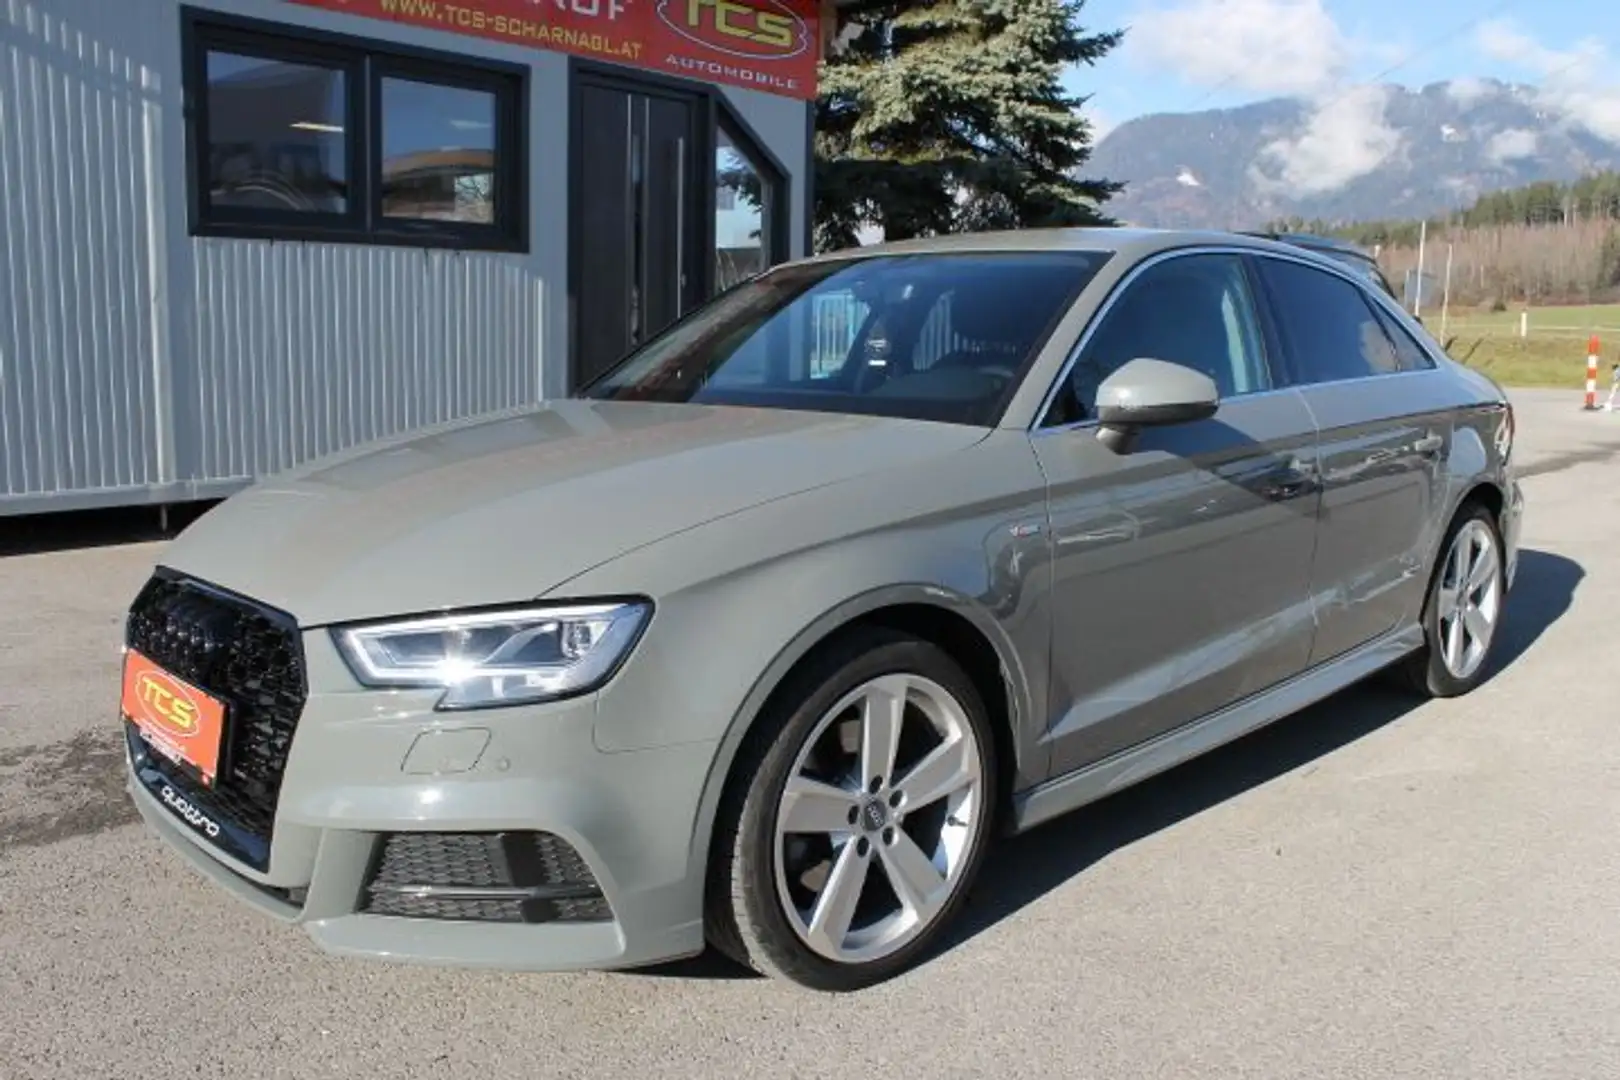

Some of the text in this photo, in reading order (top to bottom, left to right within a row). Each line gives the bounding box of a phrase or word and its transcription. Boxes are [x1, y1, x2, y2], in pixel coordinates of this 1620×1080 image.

[686, 0, 795, 48] TCS
[665, 53, 798, 90] AUTOMOBILE
[141, 675, 196, 730] TCS
[161, 785, 220, 837] quattro
